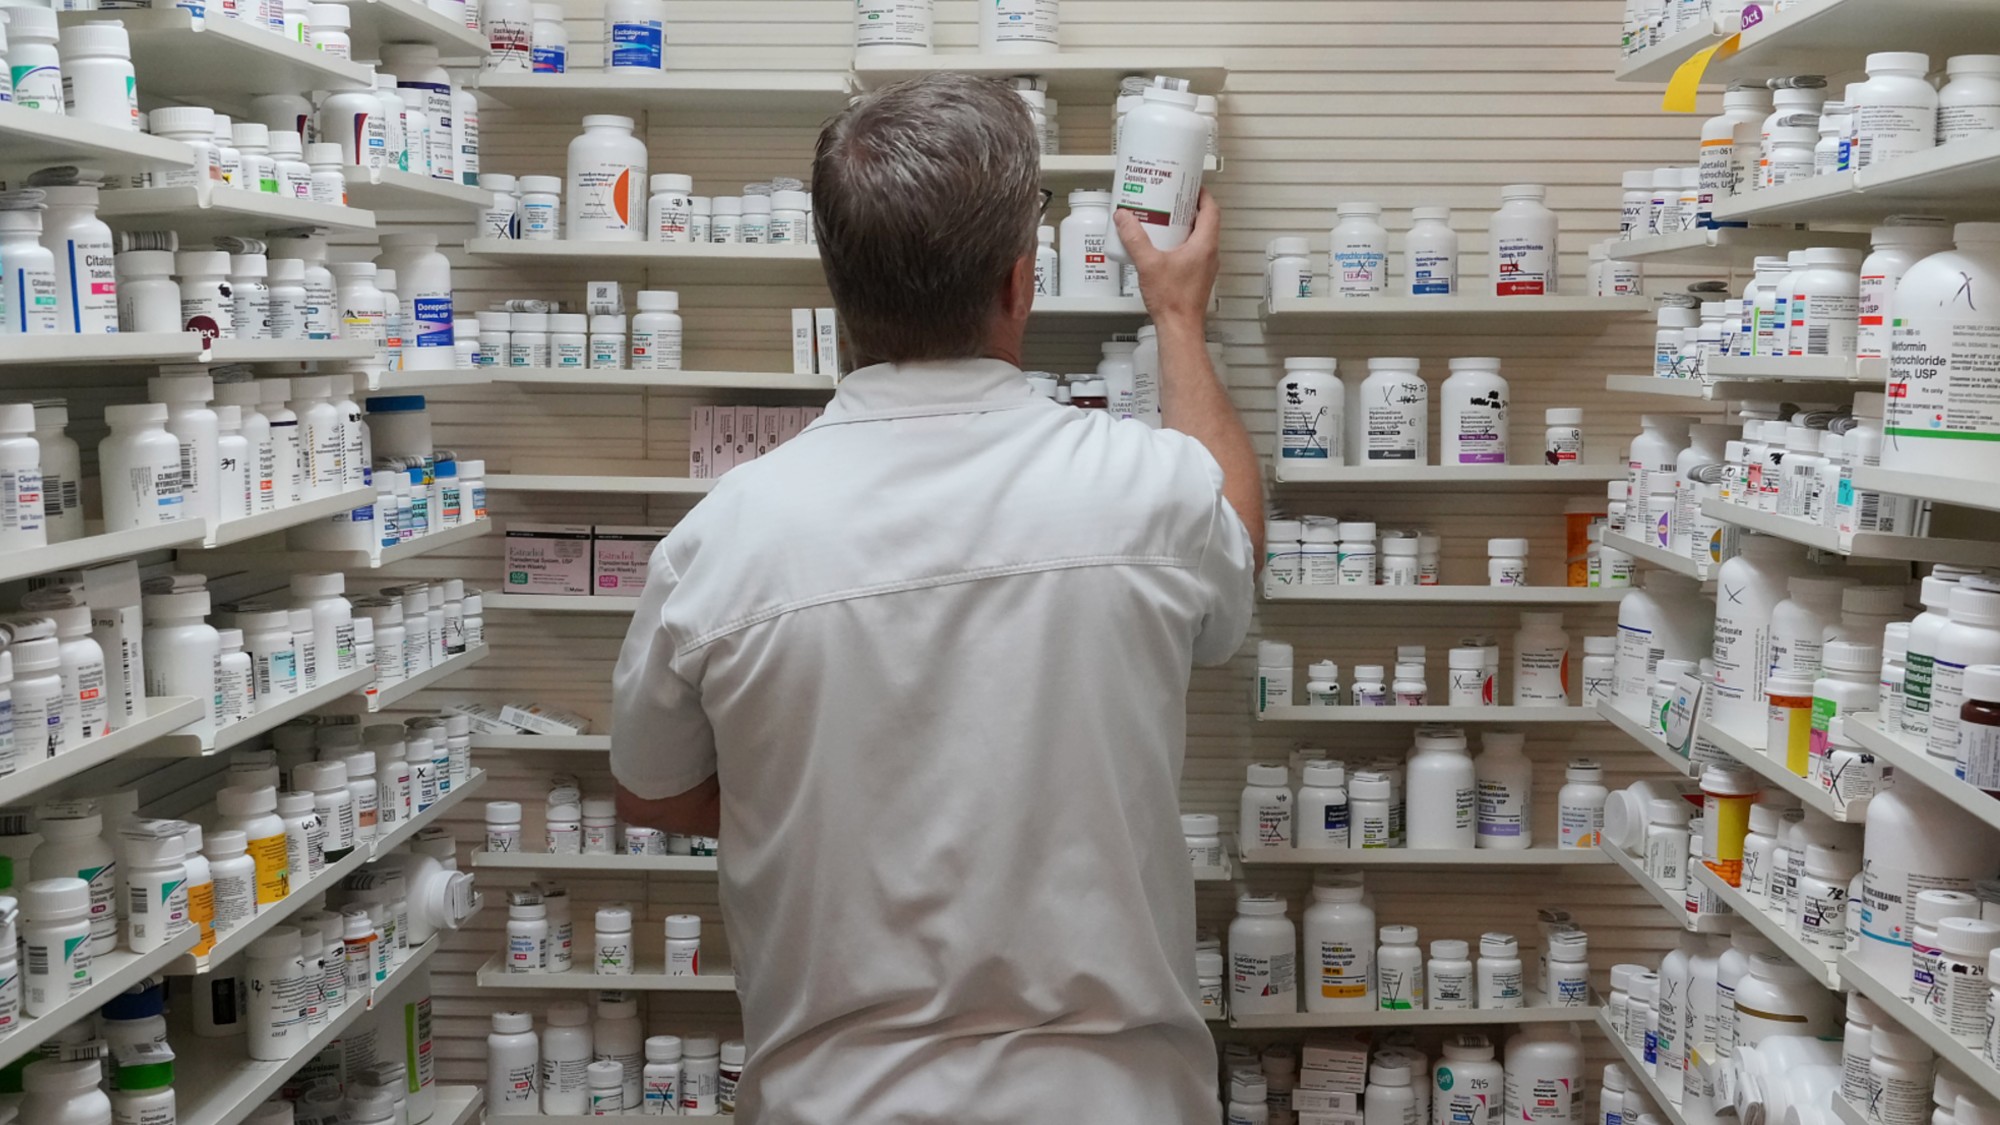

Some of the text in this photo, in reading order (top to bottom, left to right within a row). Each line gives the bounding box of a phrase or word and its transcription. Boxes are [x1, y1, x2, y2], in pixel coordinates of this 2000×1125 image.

[1126, 164, 1172, 179] FLUOXETINE
[1124, 174, 1163, 185] Capsules, USP
[85, 255, 114, 268] Citalop
[1891, 342, 1926, 352] Metformin
[1890, 356, 1947, 366] Hydrochloride
[1915, 369, 1937, 379] USP
[99, 619, 114, 628] mg
[1971, 965, 1984, 976] 24
